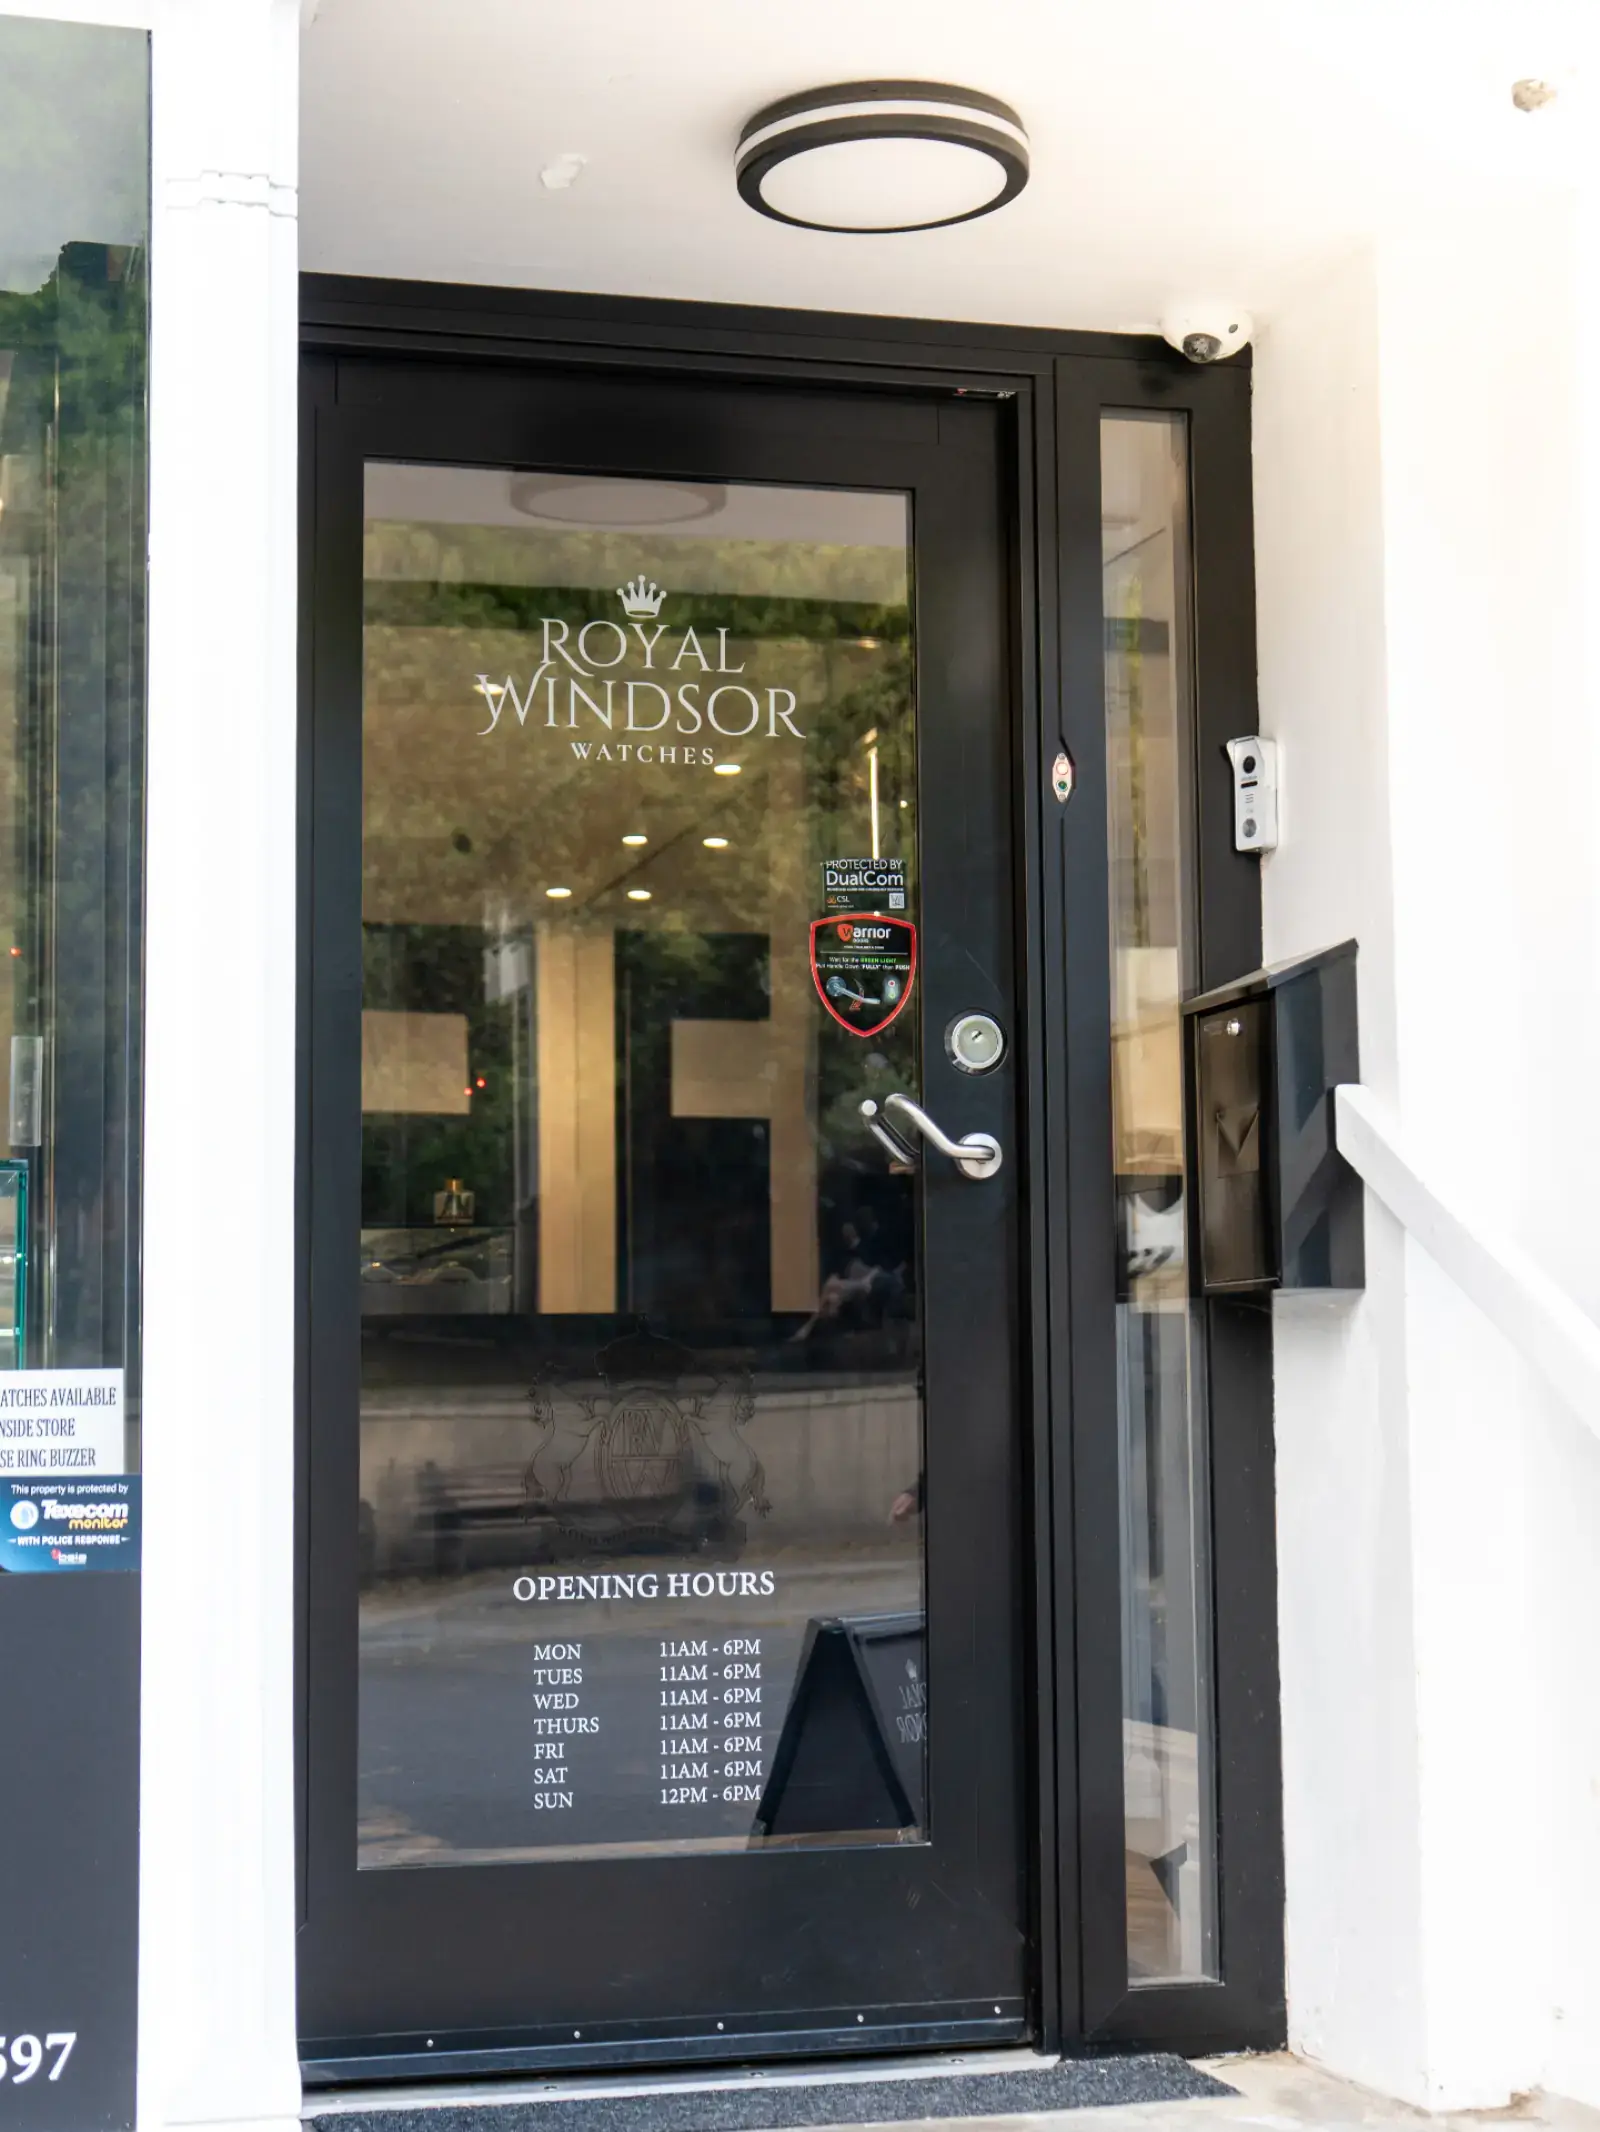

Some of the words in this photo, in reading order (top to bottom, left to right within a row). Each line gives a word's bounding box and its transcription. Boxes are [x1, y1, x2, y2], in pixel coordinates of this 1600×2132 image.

[539, 618, 745, 677] ROYAL
[474, 661, 806, 739] WINDSOR
[570, 742, 714, 765] WATCHES
[826, 860, 887, 869] PROTECTED
[890, 860, 902, 869] BY
[826, 870, 903, 885] DualCom
[50, 1387, 116, 1406] AVAILABLE
[37, 1418, 75, 1437] STORE
[17, 1449, 47, 1467] RING
[50, 1448, 96, 1467] BUZZER
[11, 1484, 29, 1494] This
[31, 1484, 65, 1495] property
[68, 1484, 74, 1493] is
[77, 1483, 116, 1494] protected
[118, 1484, 129, 1494] by
[69, 1517, 128, 1529] monitor
[18, 1536, 40, 1545] WITH
[42, 1536, 72, 1545] POLICE
[75, 1535, 120, 1544] RESPONSE
[513, 1574, 658, 1601] OPENING
[667, 1571, 774, 1598] HOURS
[534, 1644, 582, 1660] MON
[660, 1640, 707, 1657] 11AM
[724, 1639, 761, 1655] 6PM
[534, 1668, 582, 1685] TUES
[660, 1665, 707, 1682] 11AM
[724, 1663, 761, 1680] 6PM
[533, 1694, 579, 1710] WED
[660, 1689, 708, 1706] 11AM
[724, 1688, 761, 1704] 6PM
[534, 1717, 599, 1735] THURS
[660, 1713, 708, 1730] 11AM
[724, 1712, 761, 1728] 6PM
[534, 1743, 564, 1760] FRI
[660, 1738, 708, 1755] 11AM
[724, 1737, 761, 1753] 6PM
[534, 1767, 568, 1784] SAT
[660, 1762, 708, 1779] 11AM
[724, 1761, 761, 1777] 6PM
[534, 1792, 573, 1809] SUN
[660, 1787, 708, 1804] 12PM
[724, 1785, 762, 1802] 6PM
[0, 2032, 77, 2084] 97
